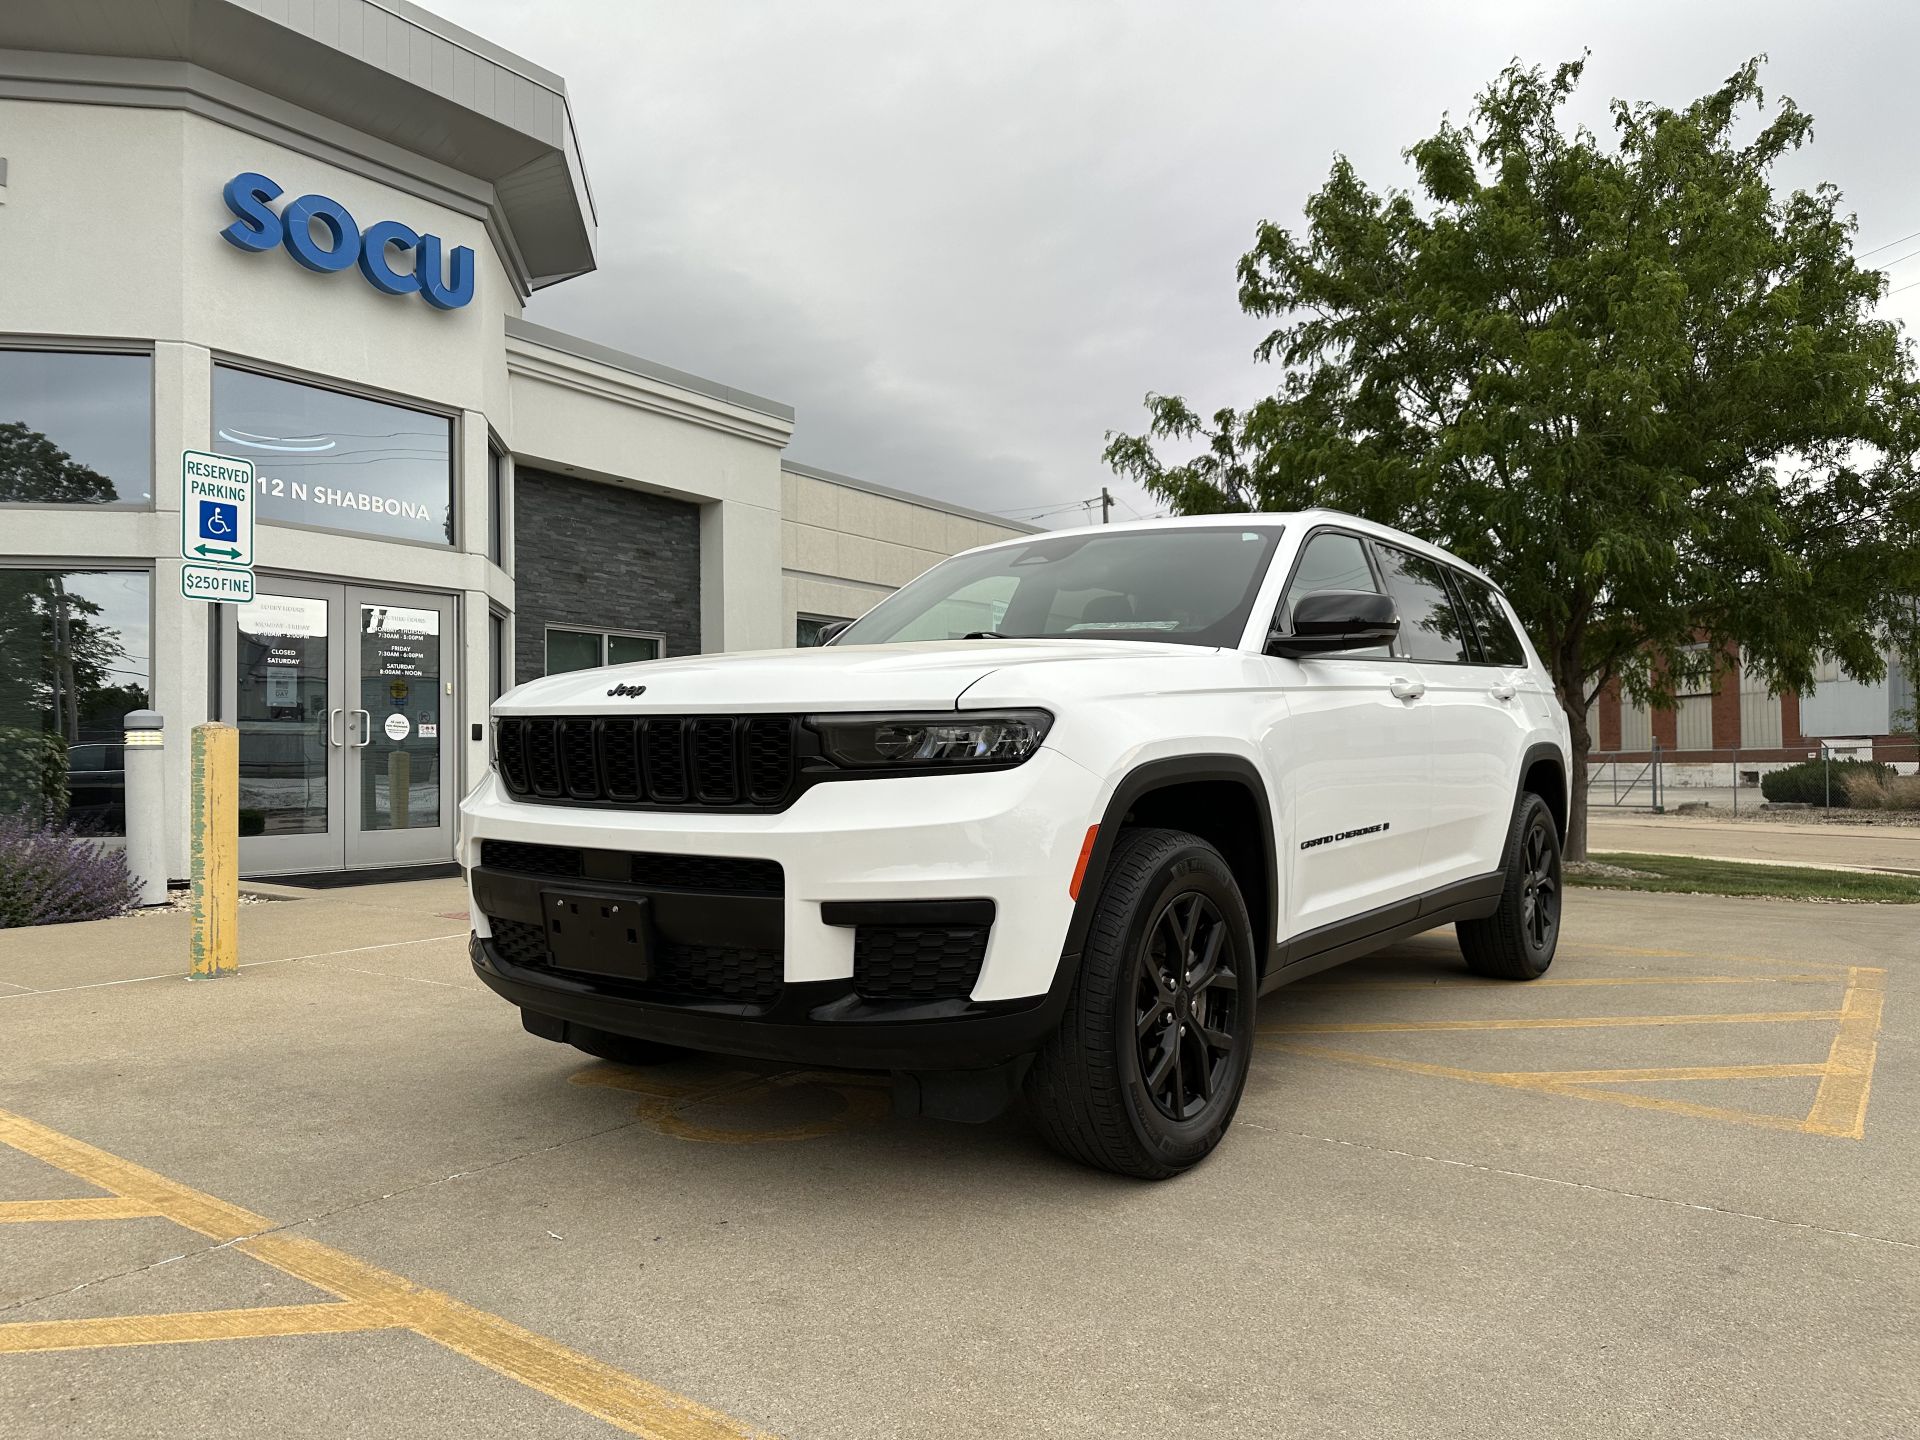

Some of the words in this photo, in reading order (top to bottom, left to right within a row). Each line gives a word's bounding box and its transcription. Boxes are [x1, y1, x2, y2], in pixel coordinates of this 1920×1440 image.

[219, 172, 475, 311] SOCU
[187, 461, 249, 484] RESERVED
[191, 480, 245, 502] PARKING
[291, 481, 307, 501] N
[313, 486, 431, 521] SHABBONA
[186, 573, 219, 590] $250
[221, 578, 250, 593] FINE
[267, 657, 300, 665] SATURDAY
[271, 648, 296, 656] CLOSED
[607, 683, 647, 699] Jeep
[1300, 835, 1333, 850] GRAND
[1335, 824, 1382, 841] CHEROKEE
